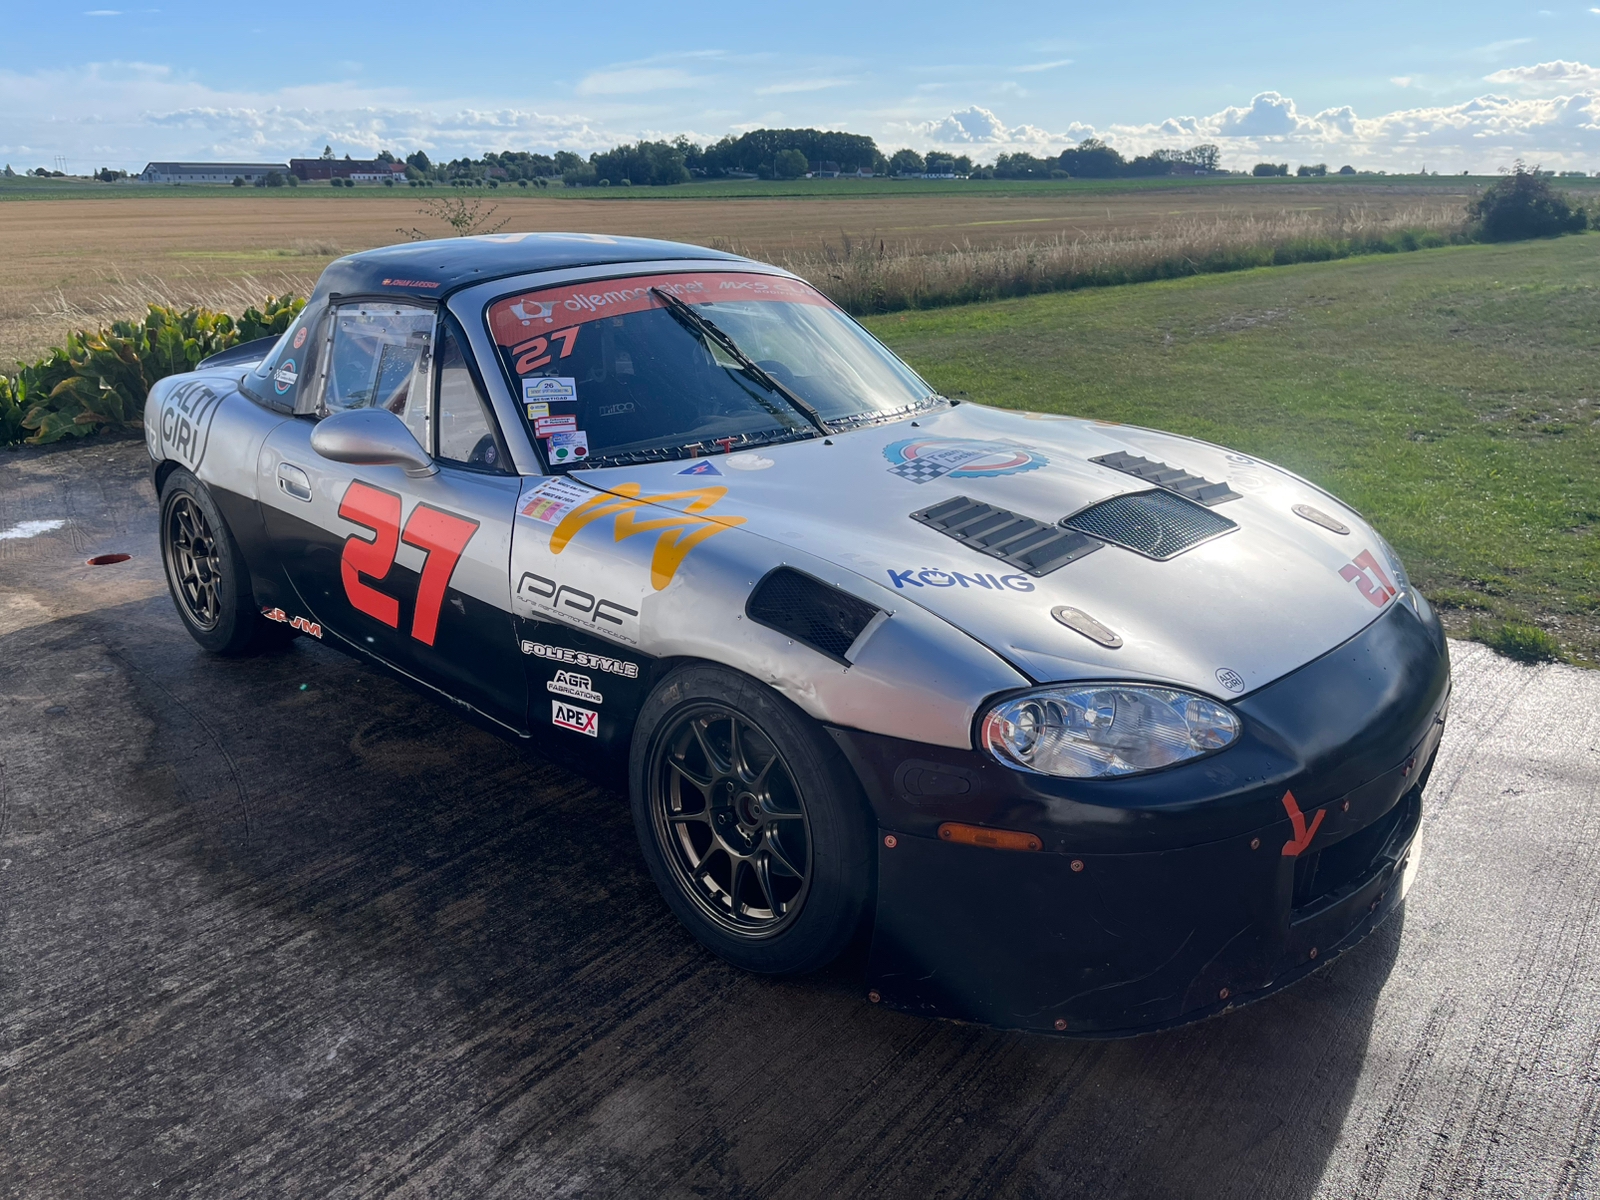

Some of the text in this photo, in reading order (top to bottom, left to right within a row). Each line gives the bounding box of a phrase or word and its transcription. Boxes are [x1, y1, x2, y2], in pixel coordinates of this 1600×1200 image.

[512, 326, 580, 374] 27
[170, 381, 218, 426] ALTI
[163, 407, 198, 464] CIRI
[338, 478, 481, 647] 27
[886, 567, 1036, 593] KÖNIG
[1338, 548, 1397, 609] 27
[516, 571, 639, 626] PPF
[548, 683, 602, 702] FABRICATIONS
[555, 672, 590, 690] AGR
[1219, 671, 1236, 682] ALTI
[555, 706, 597, 730] APEX
